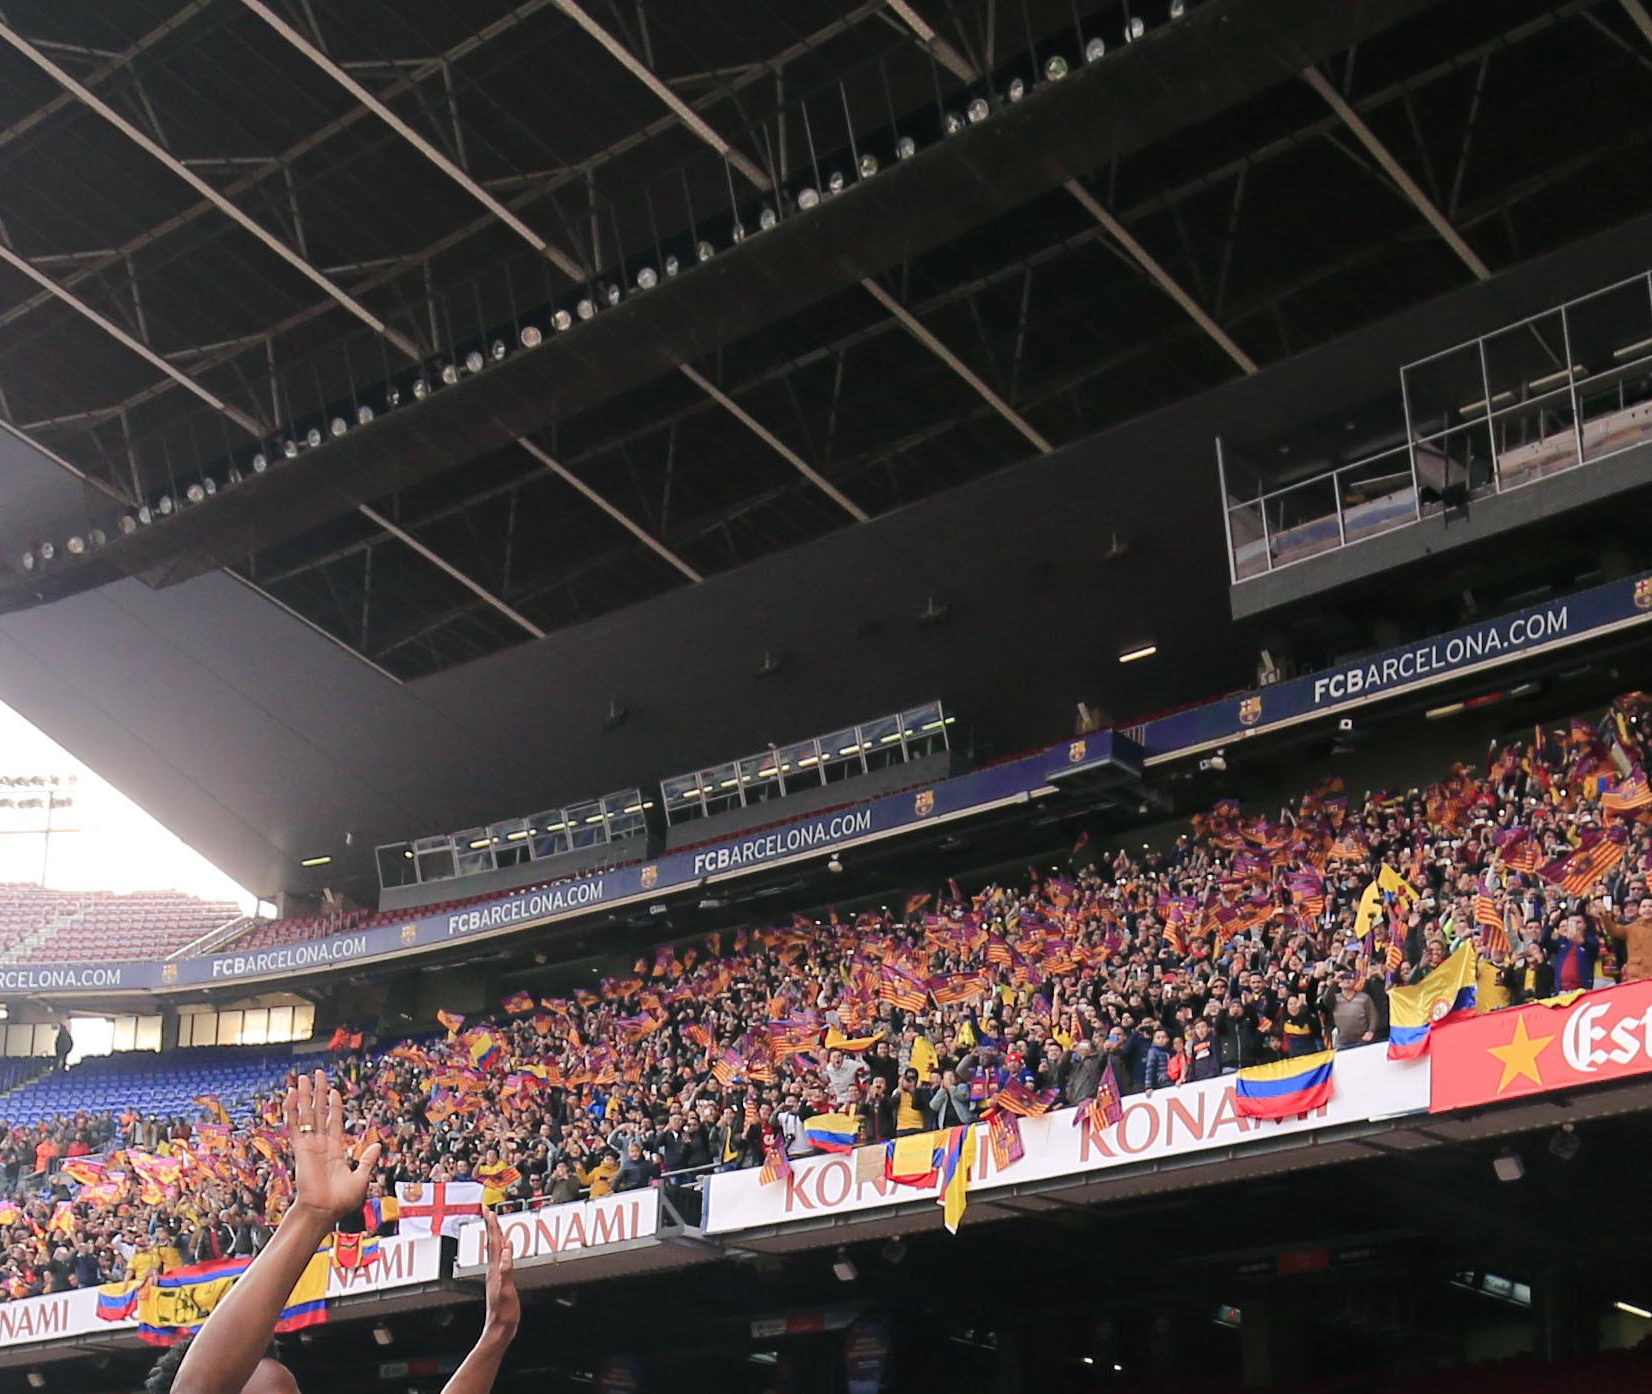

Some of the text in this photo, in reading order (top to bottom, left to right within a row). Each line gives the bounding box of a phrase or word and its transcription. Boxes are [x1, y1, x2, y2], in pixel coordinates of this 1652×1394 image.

[1313, 606, 1569, 703] FCBARCELONA.COM
[693, 809, 872, 875] FCBARCELONA.COM
[448, 880, 604, 934] FCBARCELONA.COM
[211, 936, 366, 976] FCBARCELONA.COM
[477, 1201, 639, 1265] ONAMI
